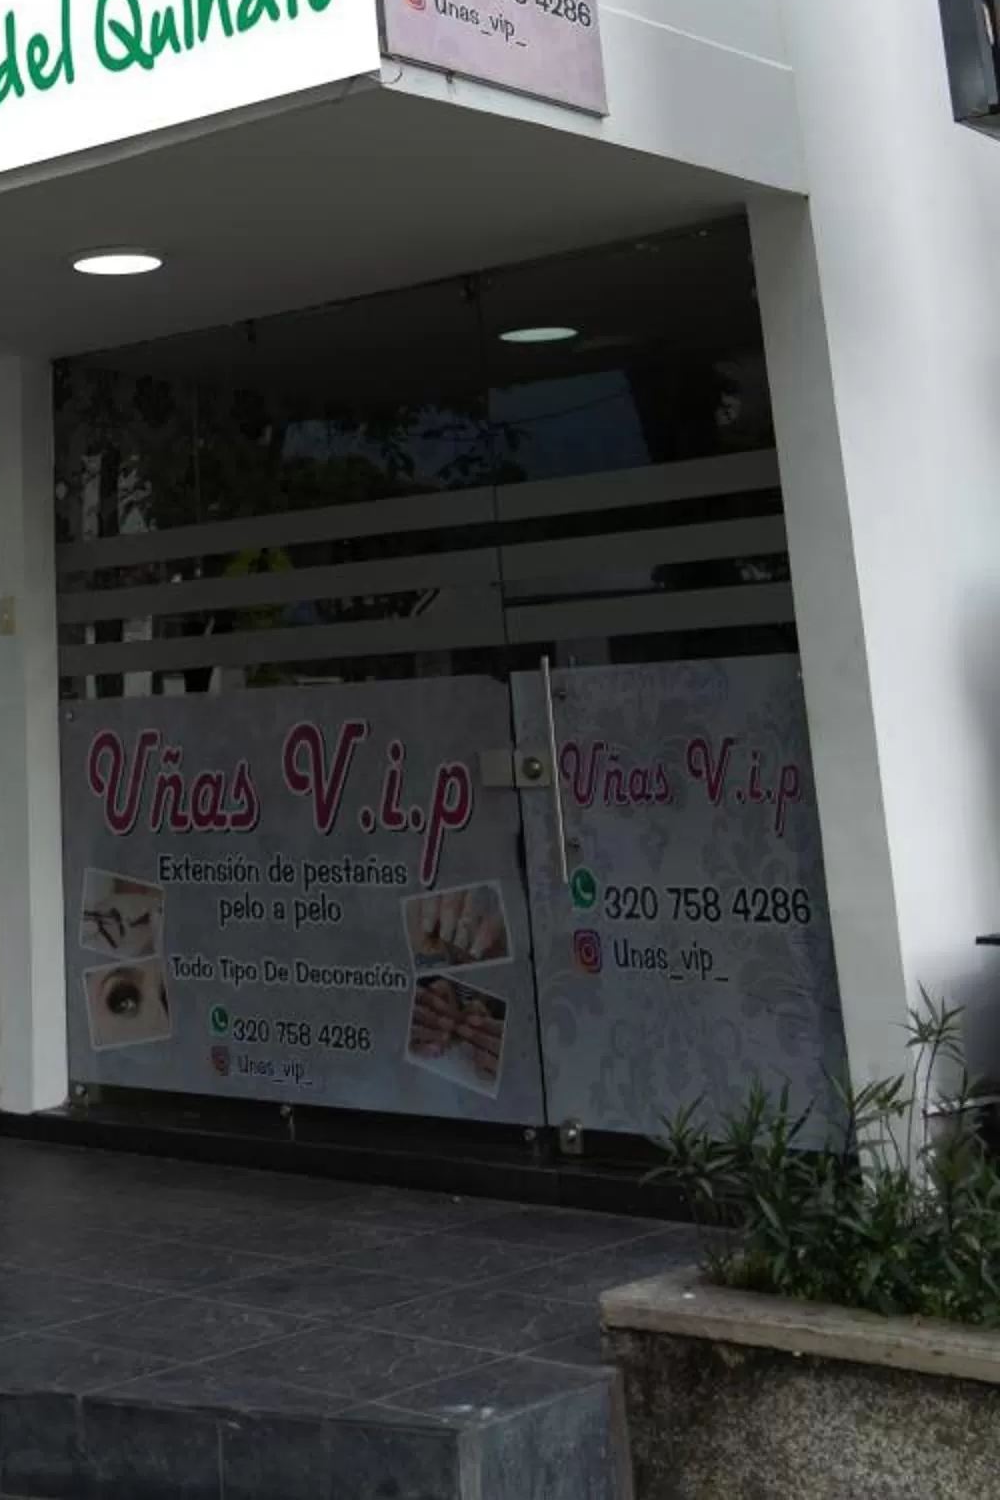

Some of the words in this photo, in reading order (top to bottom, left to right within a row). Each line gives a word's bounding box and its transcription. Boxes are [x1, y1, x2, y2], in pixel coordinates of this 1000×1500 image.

[87, 727, 260, 835] Uñas
[282, 719, 474, 890] V.i.p
[559, 738, 673, 808] Uñas
[686, 736, 801, 839] V.i.p
[158, 854, 260, 885] Extensión
[268, 855, 295, 885] de
[303, 856, 408, 890] pestañas
[219, 892, 265, 928] pelo
[273, 900, 286, 921] a
[294, 894, 342, 930] pelo
[603, 886, 658, 921] 320
[666, 886, 721, 923] 758
[731, 887, 812, 925] 4286
[171, 956, 214, 980] Todo
[220, 959, 258, 987] Tipo
[264, 962, 289, 982] De
[296, 961, 408, 989] Decoración
[232, 1018, 270, 1044] 320
[276, 1021, 312, 1047] 758
[318, 1023, 372, 1051] 4286
